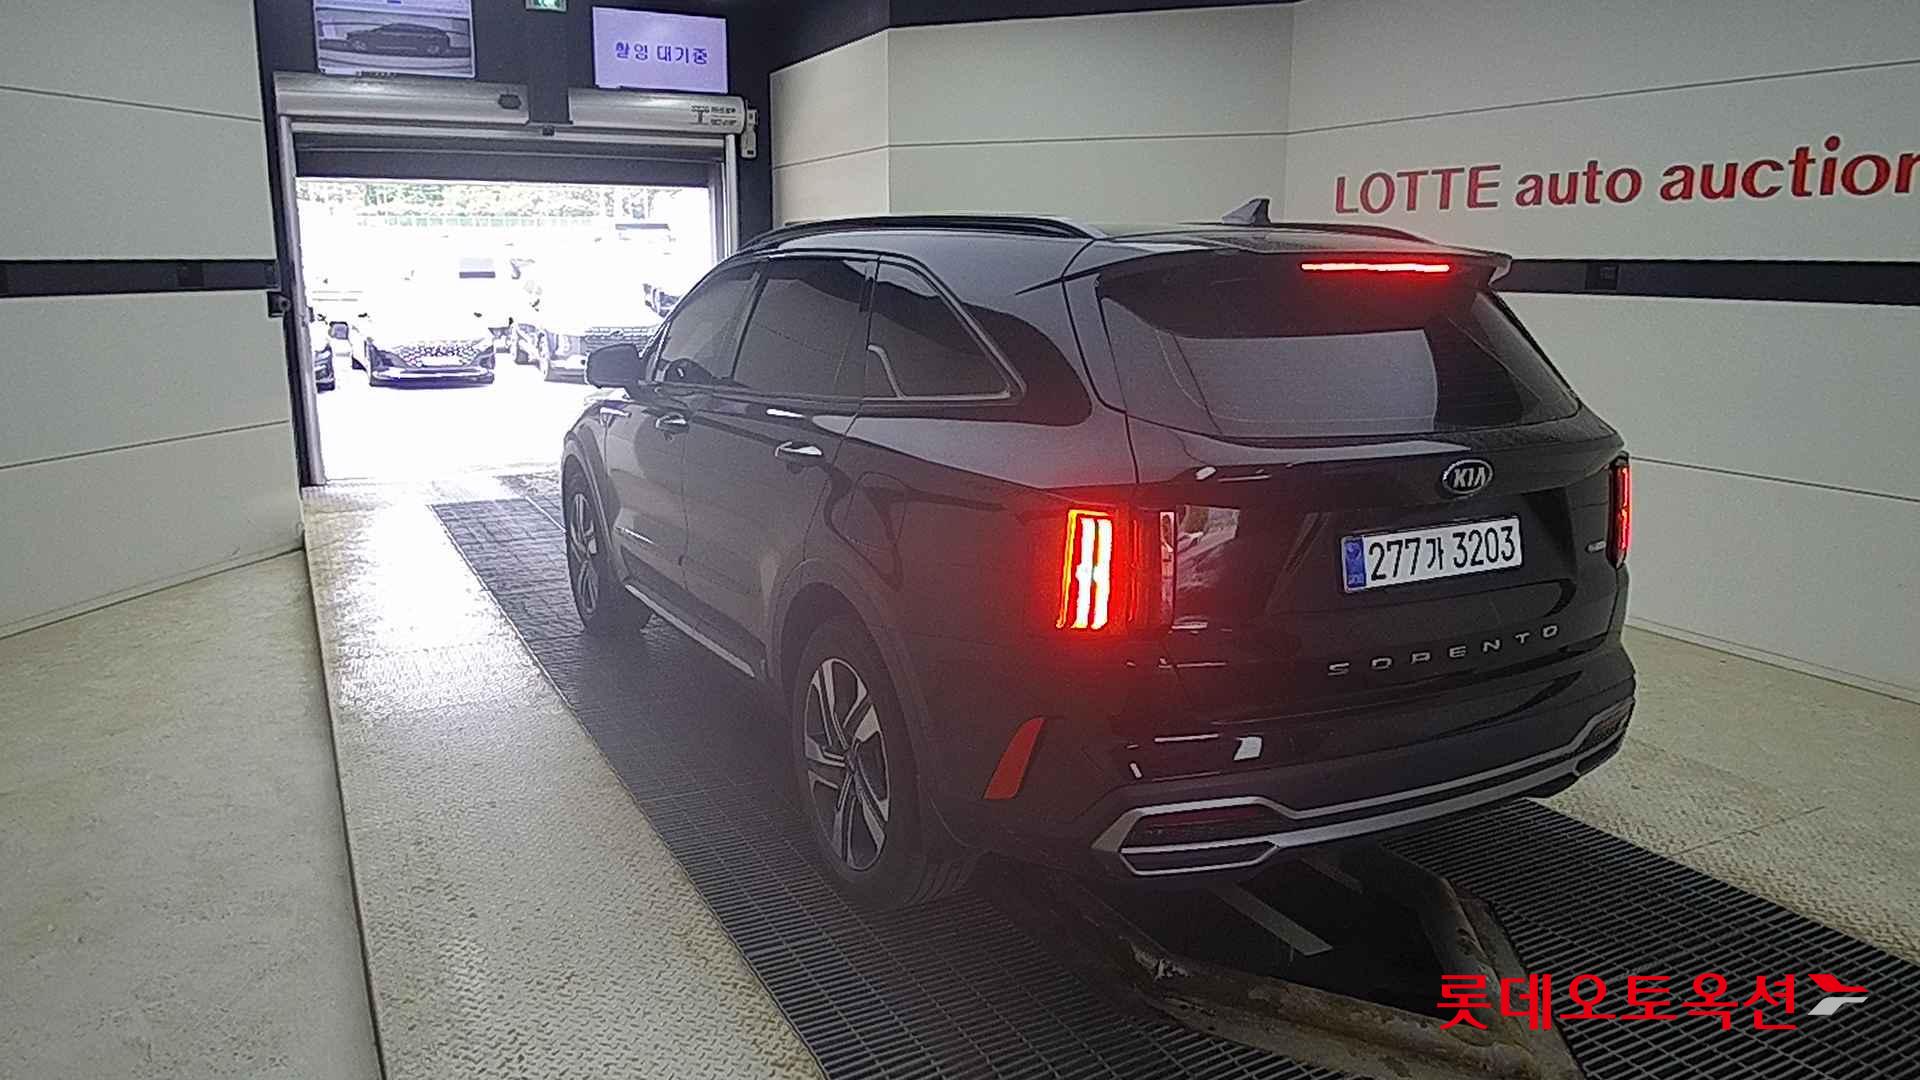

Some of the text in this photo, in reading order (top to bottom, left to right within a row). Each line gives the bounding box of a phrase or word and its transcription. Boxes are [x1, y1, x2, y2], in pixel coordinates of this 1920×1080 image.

[656, 44, 708, 65] 대기중
[1335, 163, 1502, 214] LOTTE
[1514, 159, 1642, 208] auto
[1368, 525, 1516, 582] 277가 3203
[1327, 624, 1560, 676] SORENTO
